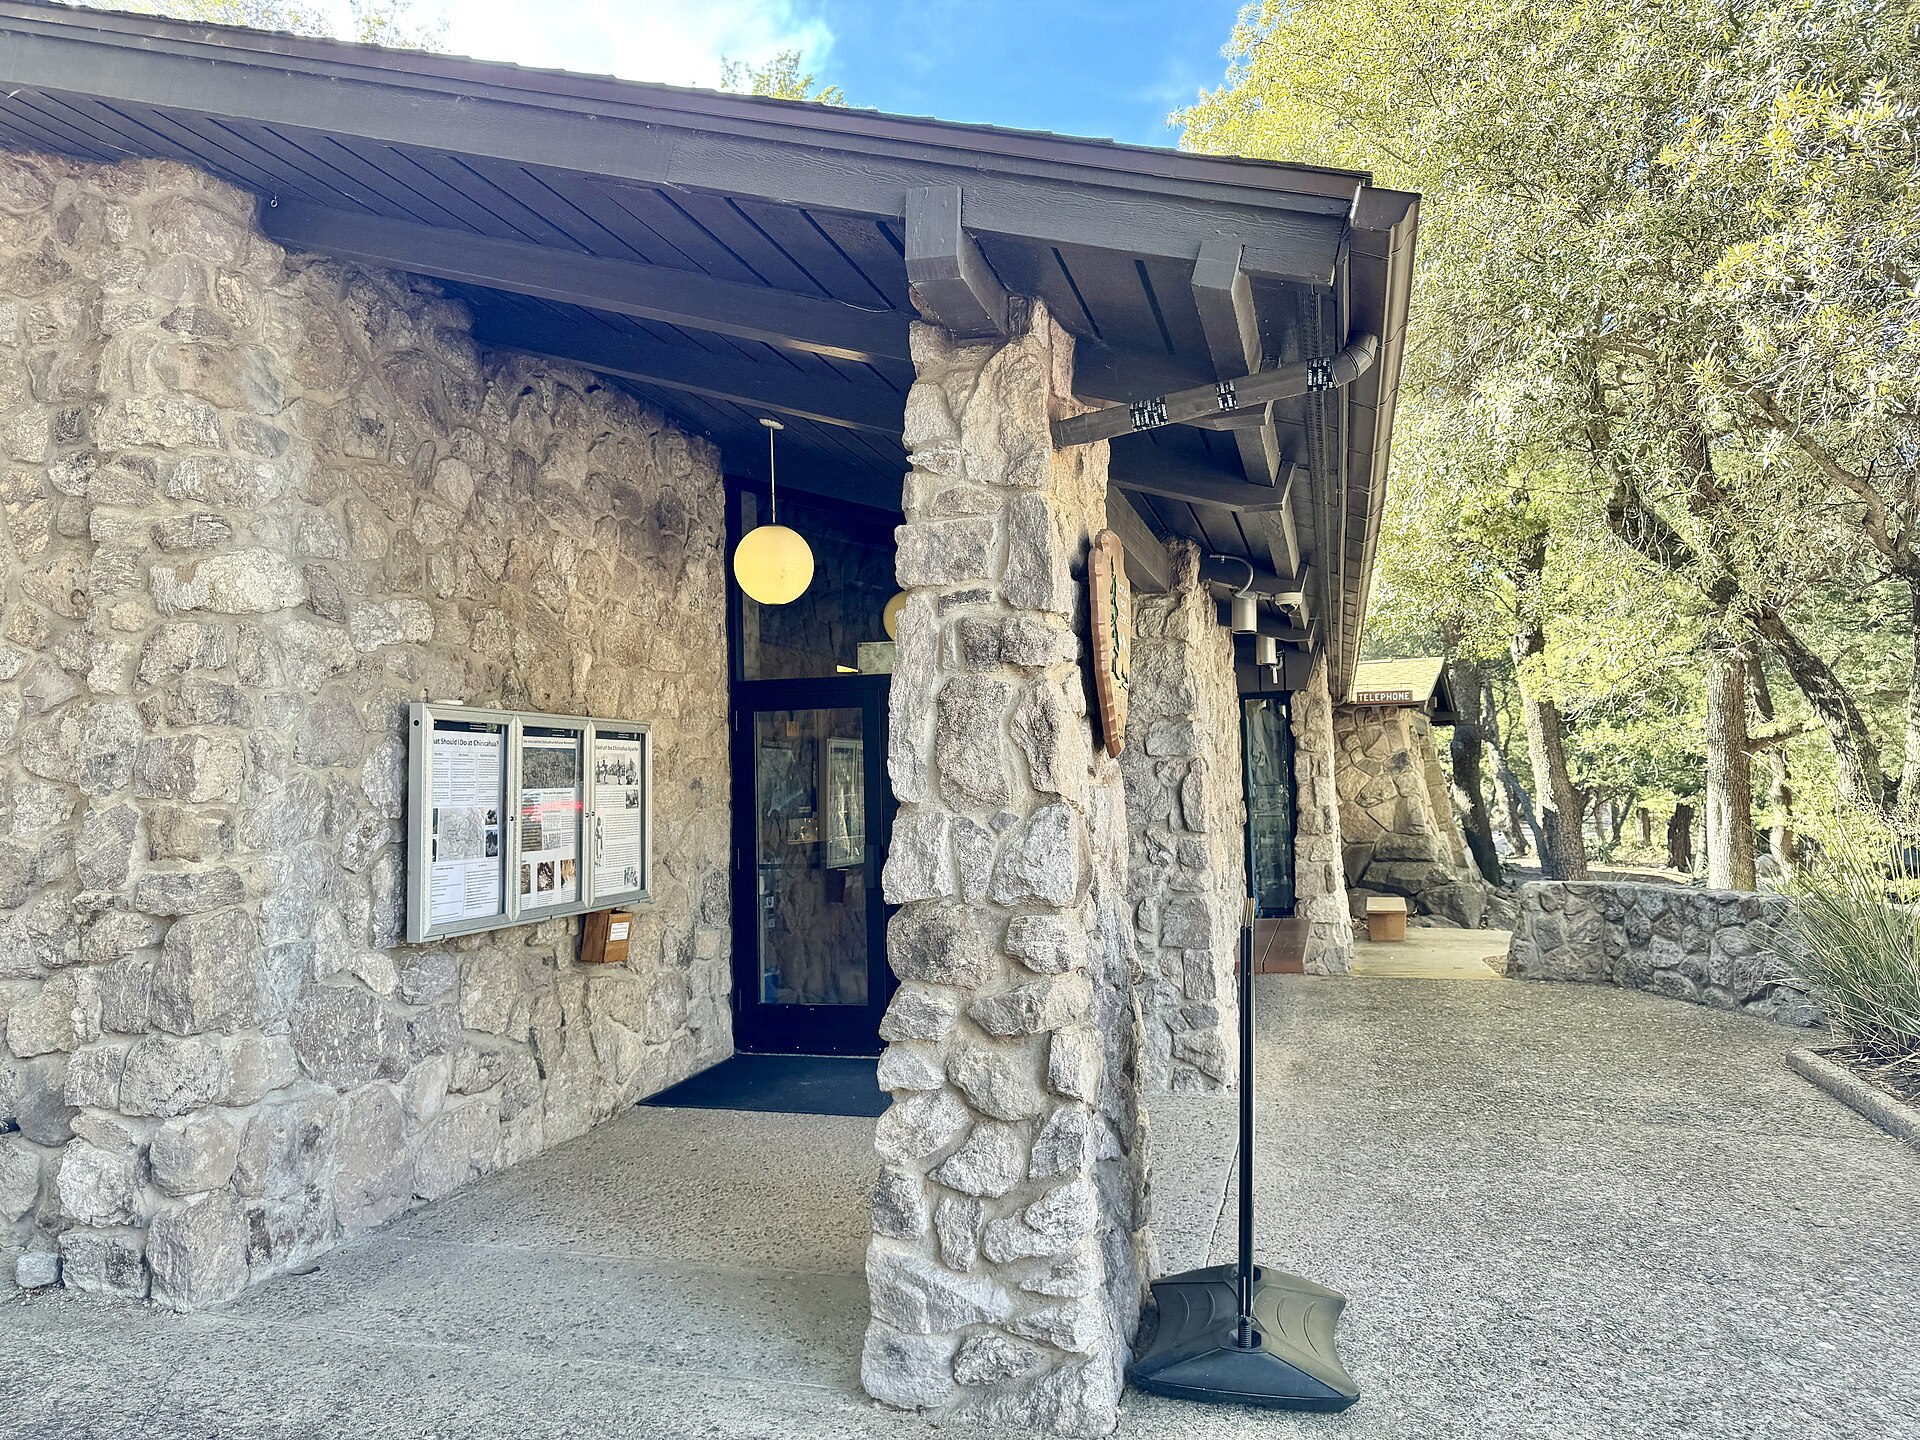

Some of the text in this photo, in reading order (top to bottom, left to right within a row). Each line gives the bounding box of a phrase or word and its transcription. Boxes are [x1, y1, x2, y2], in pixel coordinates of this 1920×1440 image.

[1358, 692, 1410, 702] TELEPHONE
[441, 738, 457, 746] Should
[460, 739, 468, 747] Do
